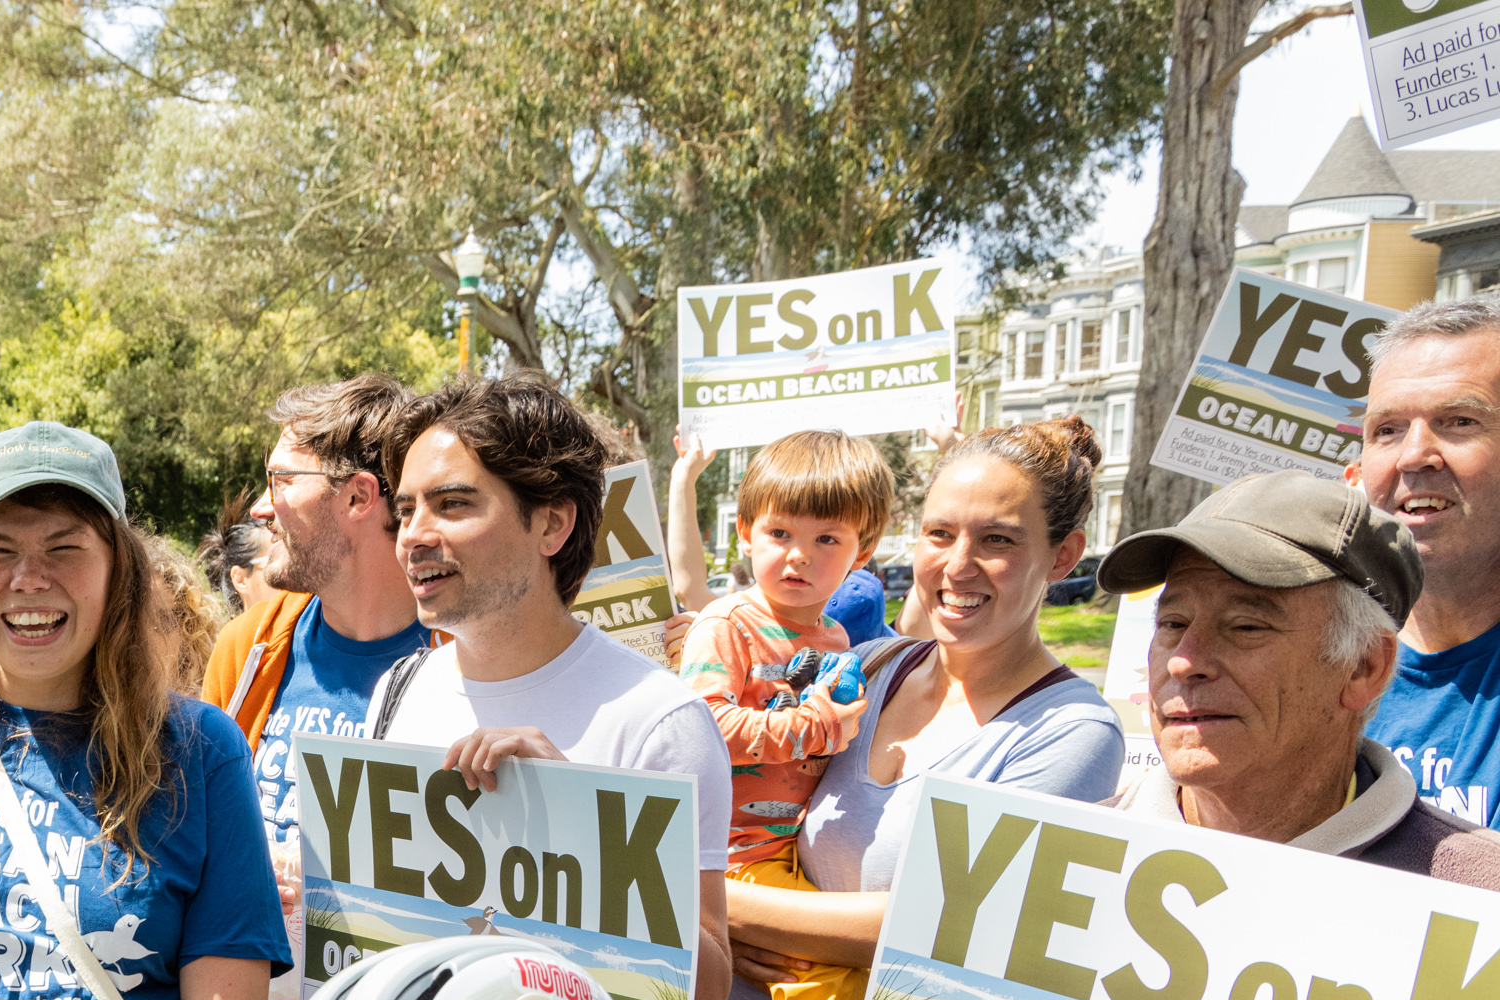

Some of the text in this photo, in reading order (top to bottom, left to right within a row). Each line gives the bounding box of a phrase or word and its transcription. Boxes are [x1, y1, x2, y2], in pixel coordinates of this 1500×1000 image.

[1403, 42, 1426, 67] Ad
[1433, 27, 1472, 63] paid
[1395, 53, 1495, 98] Funders: 1.
[1404, 87, 1480, 121] 3. Lucas
[687, 267, 944, 358] YES on K
[1227, 281, 1386, 399] YES
[696, 361, 939, 405] OCEAN BEACH PARK
[1181, 427, 1195, 438] Ad
[1194, 433, 1216, 444] paid
[1216, 437, 1229, 449] for
[1230, 441, 1242, 455] by
[1244, 445, 1259, 458] Yes
[1260, 454, 1272, 463] on
[1273, 455, 1282, 467] K,
[1197, 396, 1362, 462] OCEAN BEA
[28, 443, 39, 452] is
[41, 445, 91, 460] forever
[1168, 449, 1175, 459] 3.
[1177, 452, 1202, 467] Lucas
[1204, 460, 1219, 473] Lux
[1171, 437, 1208, 457] Funders:
[1217, 452, 1248, 472] Jeremy
[594, 476, 655, 567] K
[262, 707, 290, 737] ote
[291, 706, 330, 737] YES
[302, 753, 682, 949] YES on K
